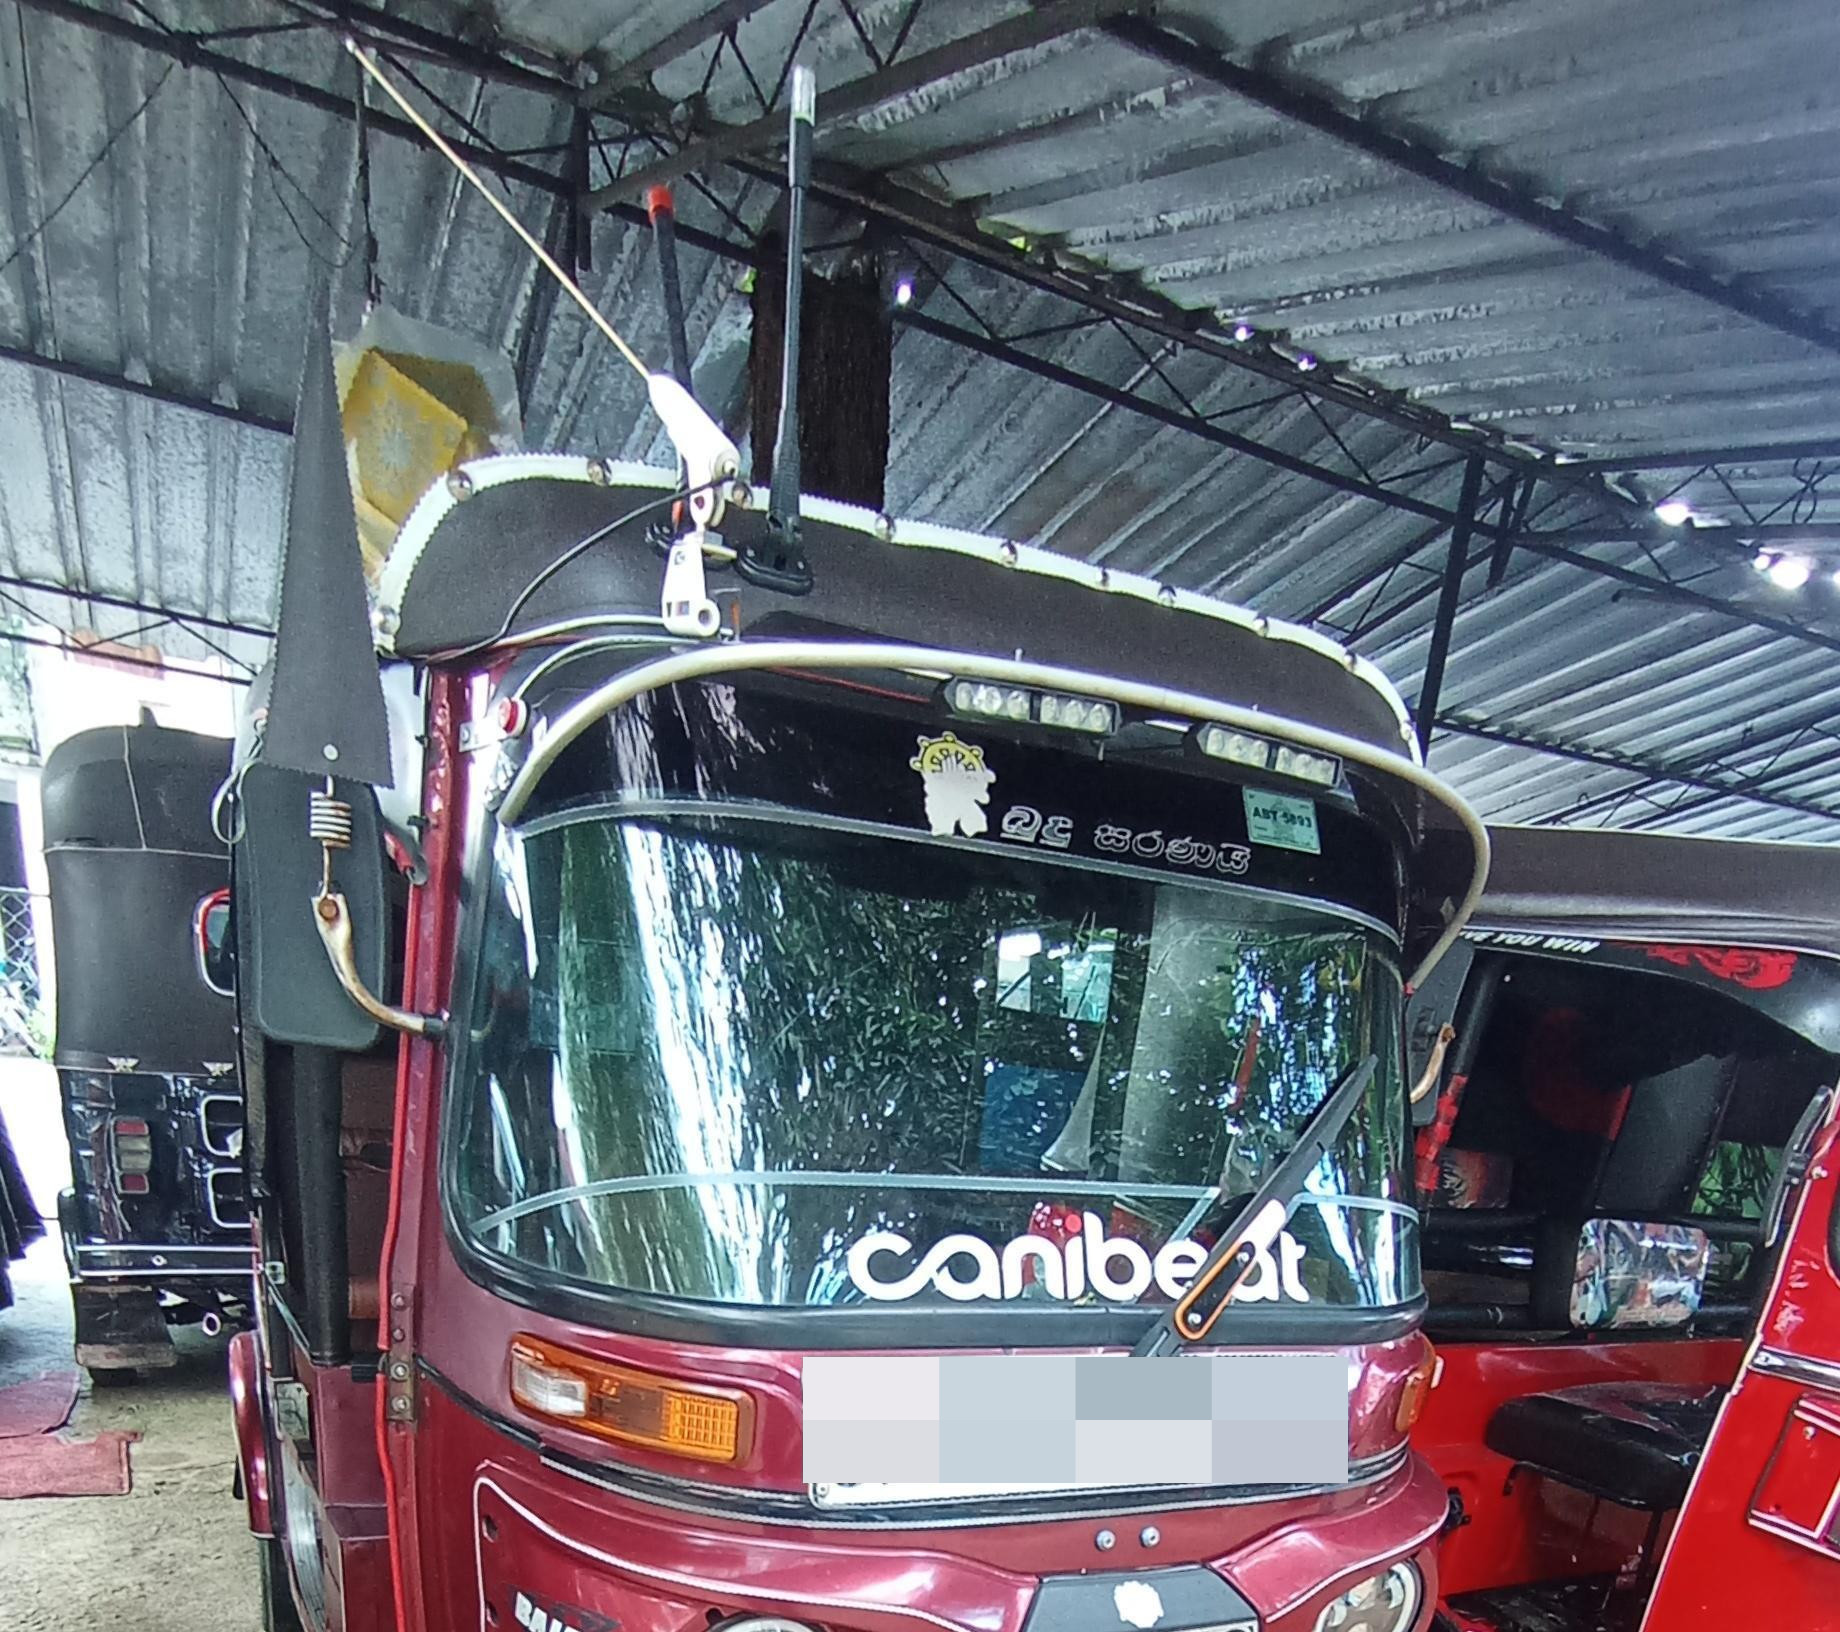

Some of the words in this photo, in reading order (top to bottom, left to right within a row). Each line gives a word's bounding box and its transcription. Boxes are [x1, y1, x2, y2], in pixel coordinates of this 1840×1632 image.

[1000, 805, 1073, 848] බුදු
[1094, 824, 1250, 874] සරණයි
[1492, 932, 1544, 946] YOU
[1543, 936, 1600, 954] WIN
